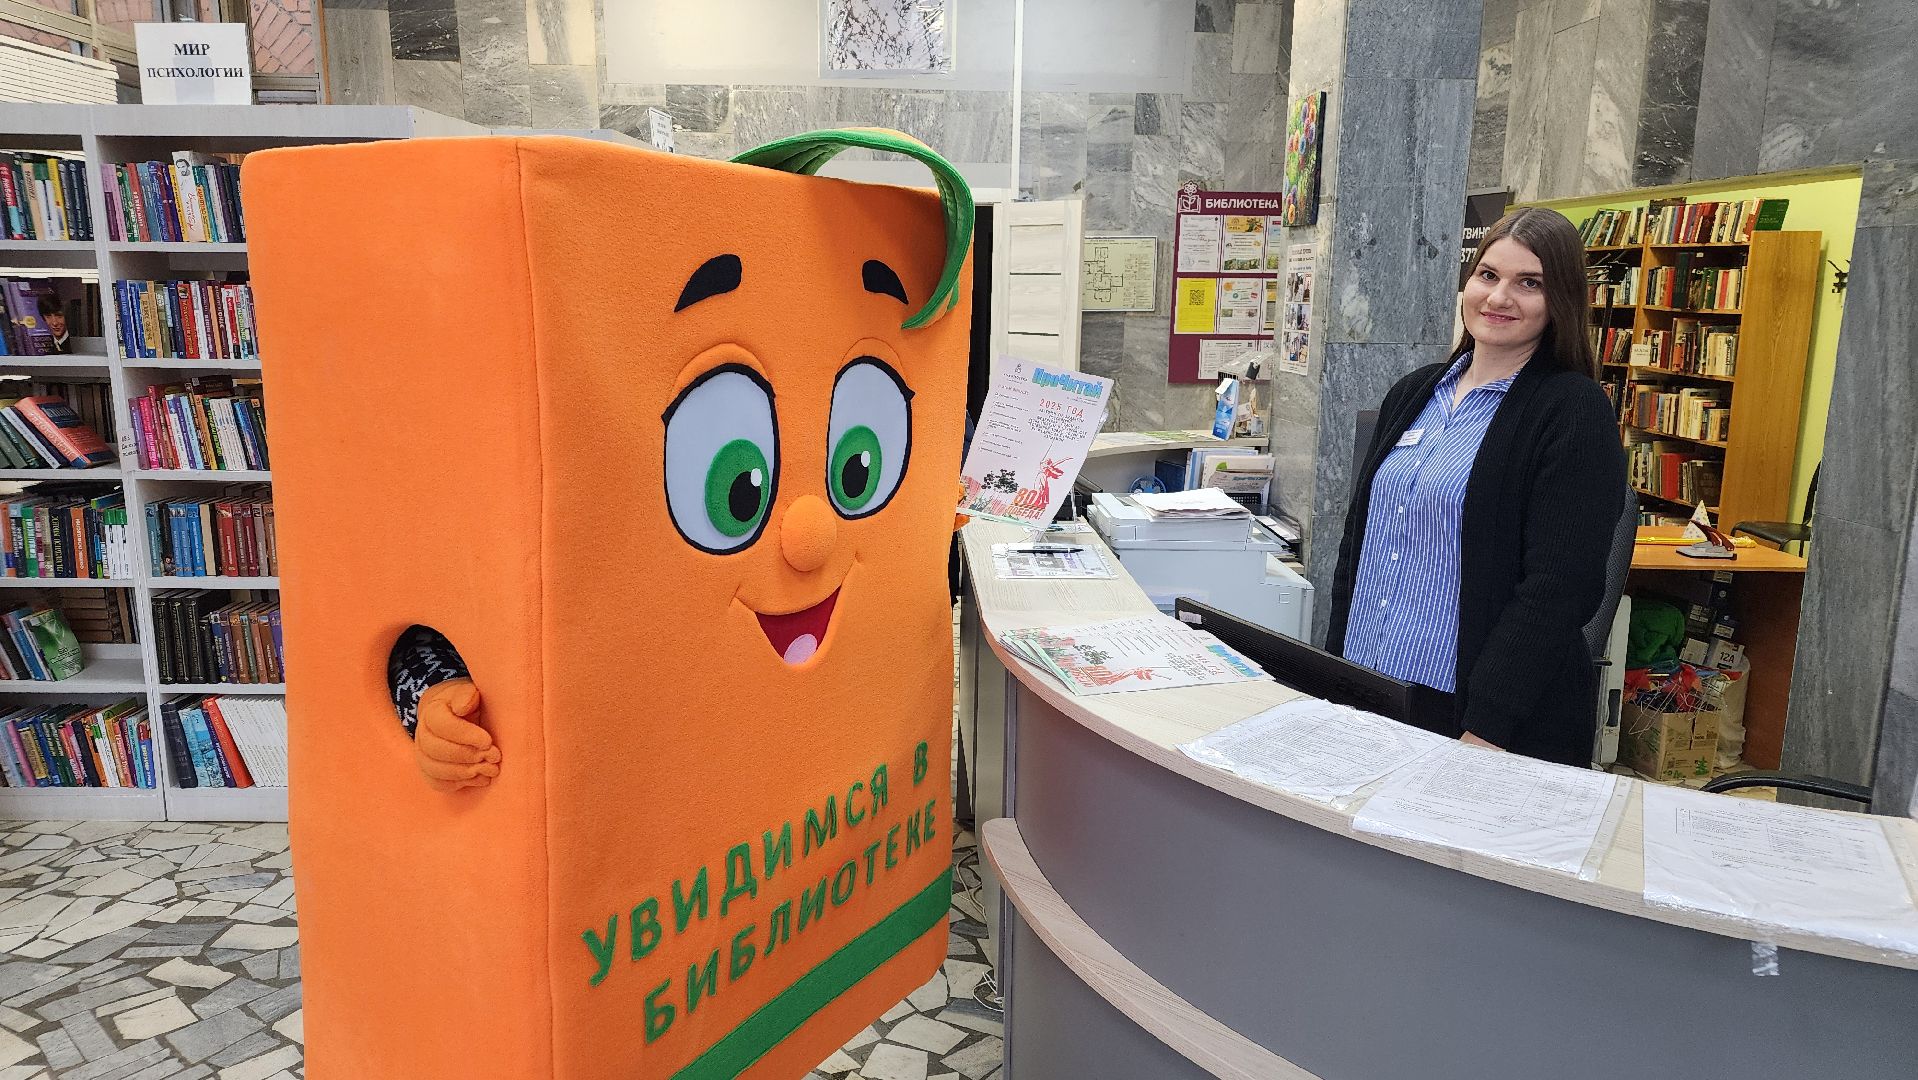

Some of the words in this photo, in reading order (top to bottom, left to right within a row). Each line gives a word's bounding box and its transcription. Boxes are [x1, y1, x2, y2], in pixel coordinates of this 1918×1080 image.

[174, 43, 210, 56] МИР
[147, 67, 244, 78] ПСИХОЛОГИИ
[1205, 198, 1279, 209] БИБЛИОТЕКА
[1040, 398, 1062, 411] 2025
[1066, 405, 1084, 418] ГОД
[1720, 651, 1735, 664] 12A
[581, 763, 888, 986] УВИДИМСЯ
[913, 740, 929, 786] В
[643, 799, 937, 1046] БИБЛИОТЕКЕ
